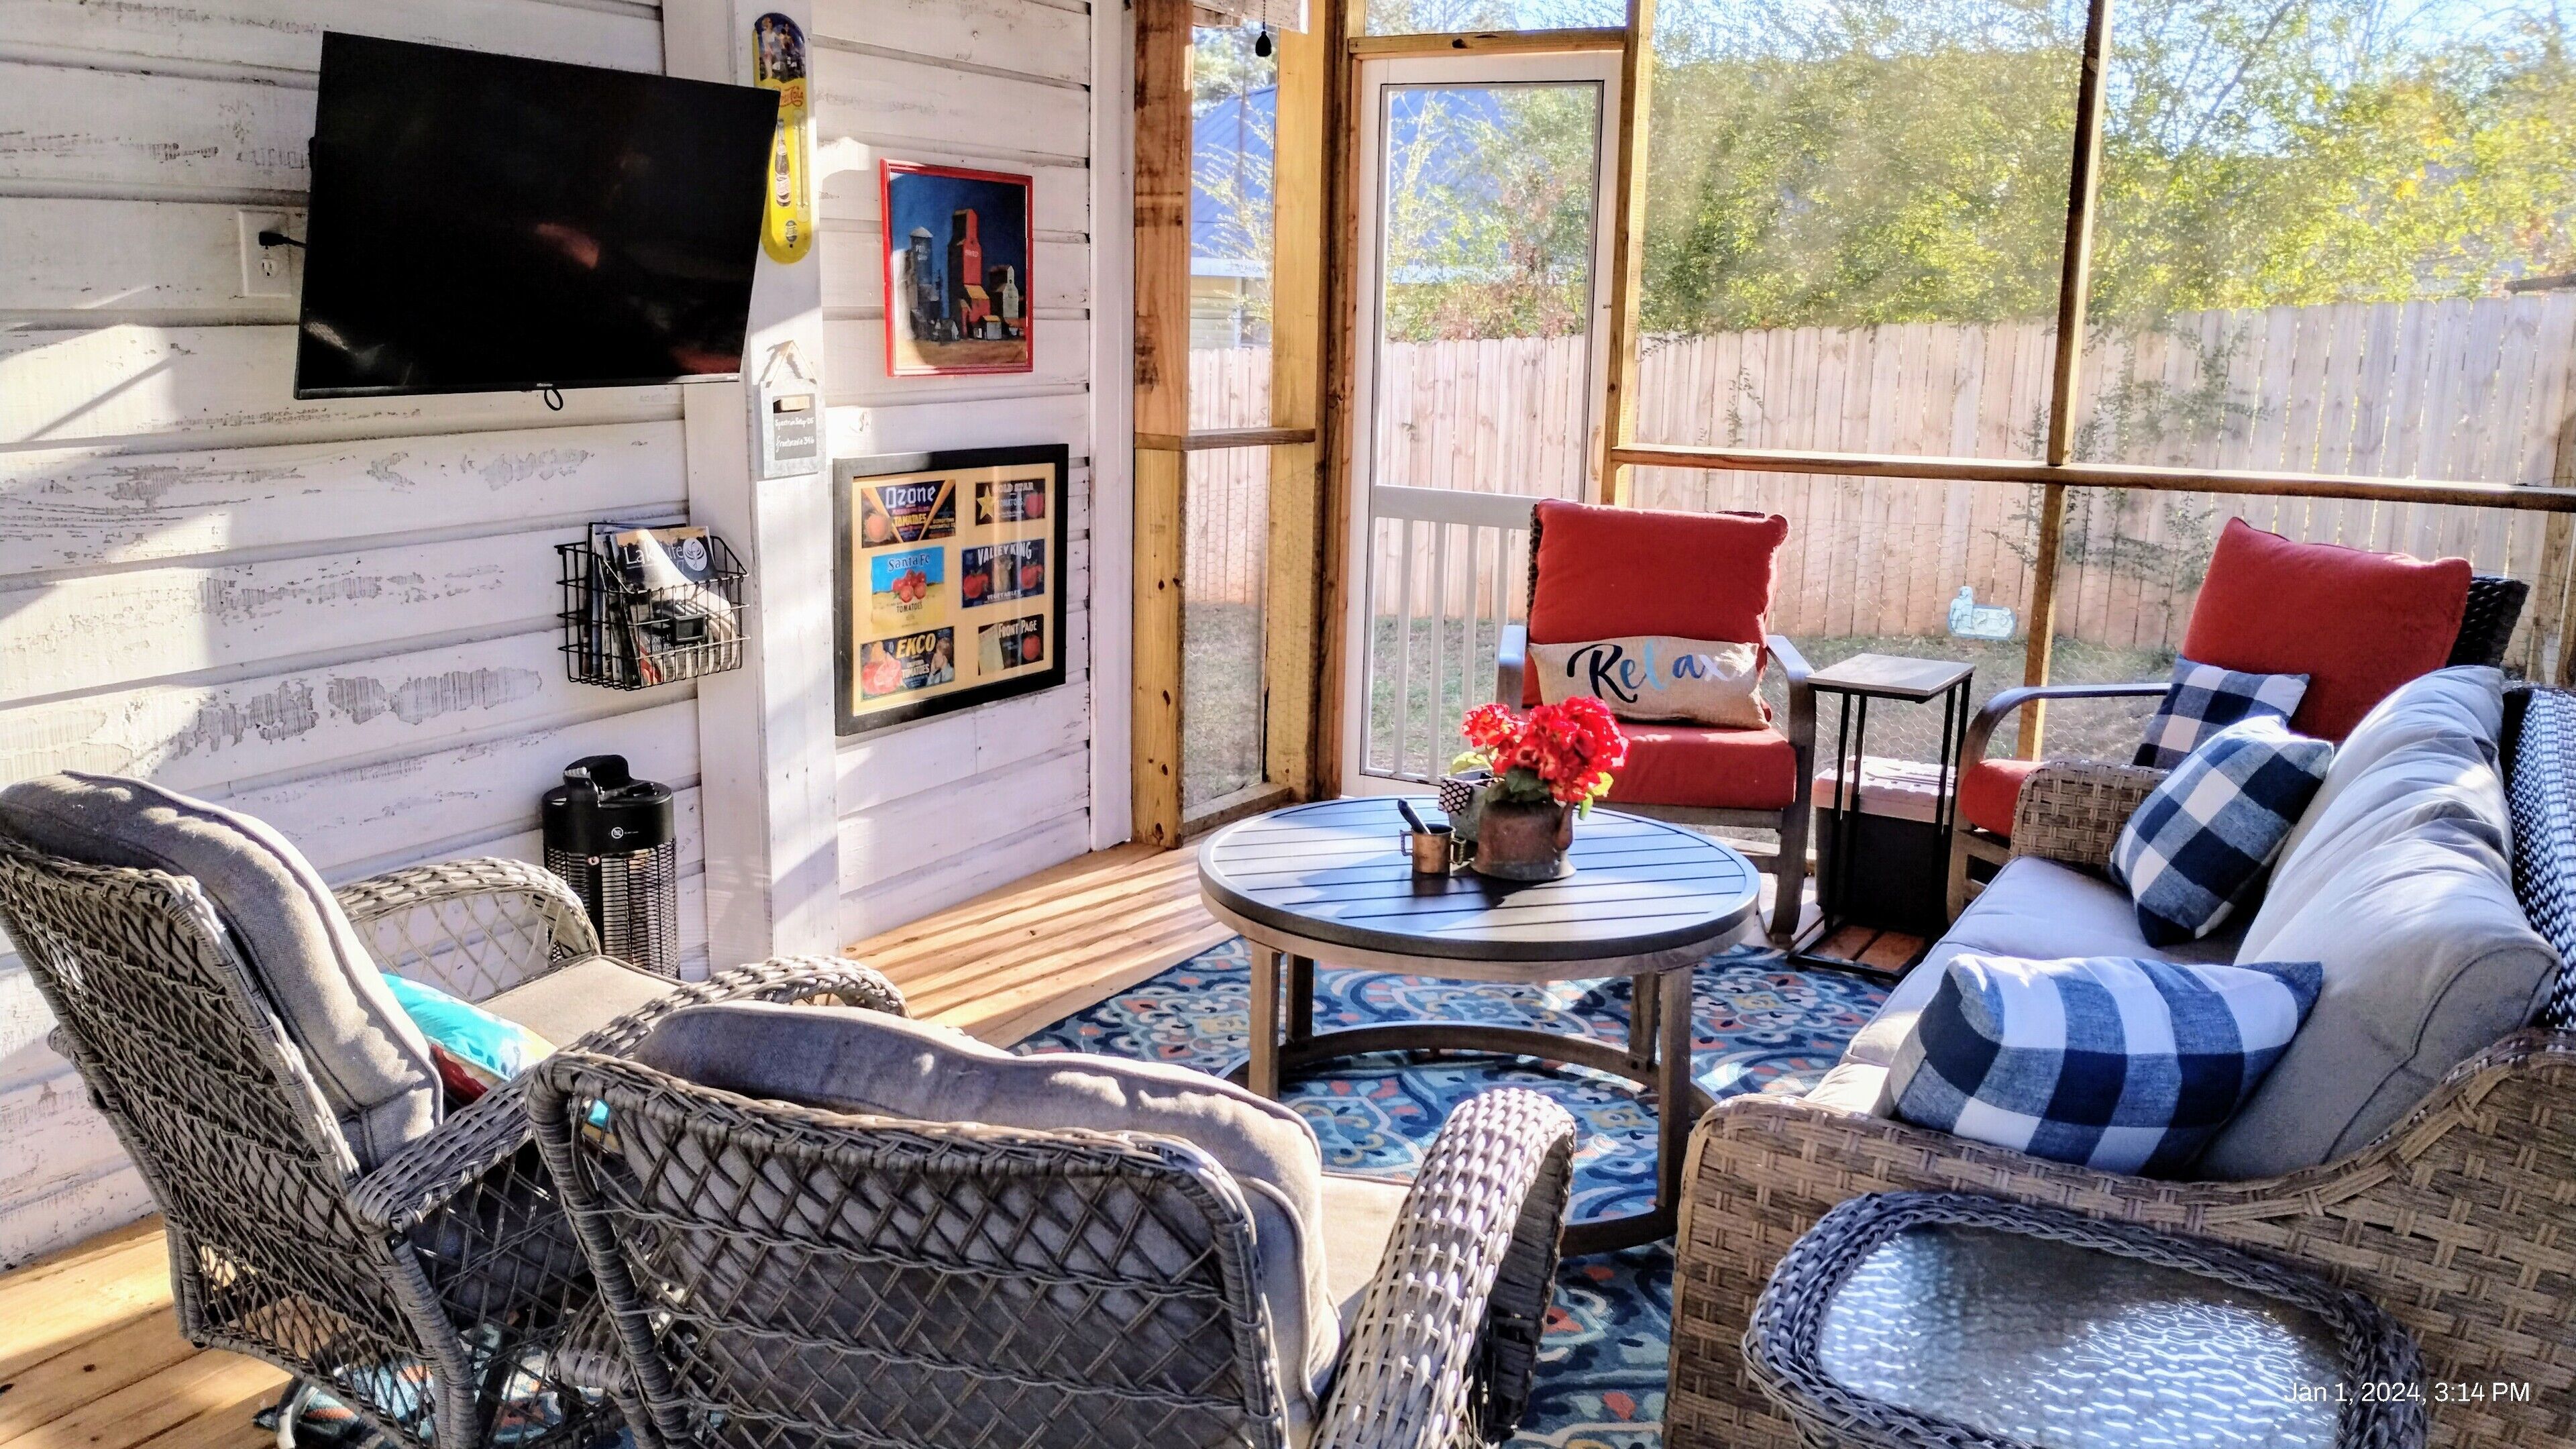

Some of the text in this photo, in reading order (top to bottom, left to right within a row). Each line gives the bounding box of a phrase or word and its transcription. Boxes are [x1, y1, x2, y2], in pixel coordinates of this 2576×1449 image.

[885, 486, 936, 509] Ozone
[624, 541, 661, 565] Lak
[888, 556, 918, 572] Santa
[978, 541, 1032, 566] VALLEY KING
[896, 602, 923, 613] TOMATOES
[998, 620, 1037, 639] FRONT PAGE
[896, 633, 936, 659] EKCO
[1566, 639, 1740, 704] Relax
